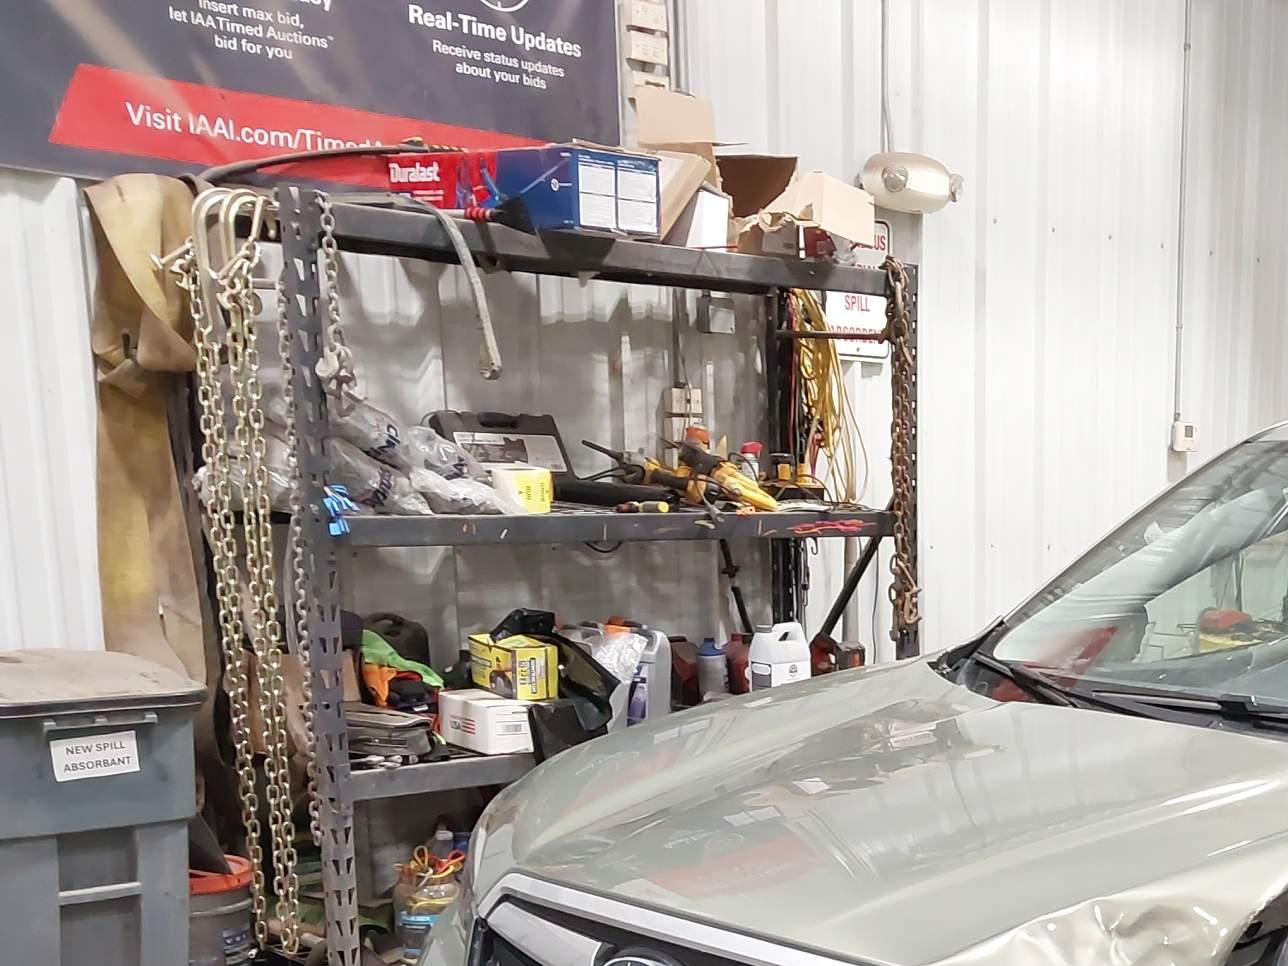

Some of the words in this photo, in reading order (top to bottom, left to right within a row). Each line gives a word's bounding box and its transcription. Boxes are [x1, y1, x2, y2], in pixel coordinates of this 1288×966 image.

[168, 6, 188, 23] let
[190, 11, 217, 29] IAA
[216, 17, 263, 37] Timed
[242, 7, 273, 21] max
[277, 11, 304, 28] bid,
[408, 4, 507, 42] Real-Time
[510, 25, 582, 58] Updates
[214, 35, 237, 51] bid
[240, 40, 263, 54] for
[265, 45, 293, 59] you
[432, 39, 481, 61] Receive
[483, 52, 519, 68] status
[521, 60, 565, 77] updates
[455, 62, 491, 79] about
[493, 70, 520, 83] your
[522, 73, 547, 90] bids
[124, 101, 181, 132] Visit
[388, 161, 441, 183] Duralast
[844, 294, 871, 313] SPILL
[65, 744, 93, 756] NEW
[95, 740, 126, 752] SPILL
[63, 756, 131, 773] ABSORBANT
